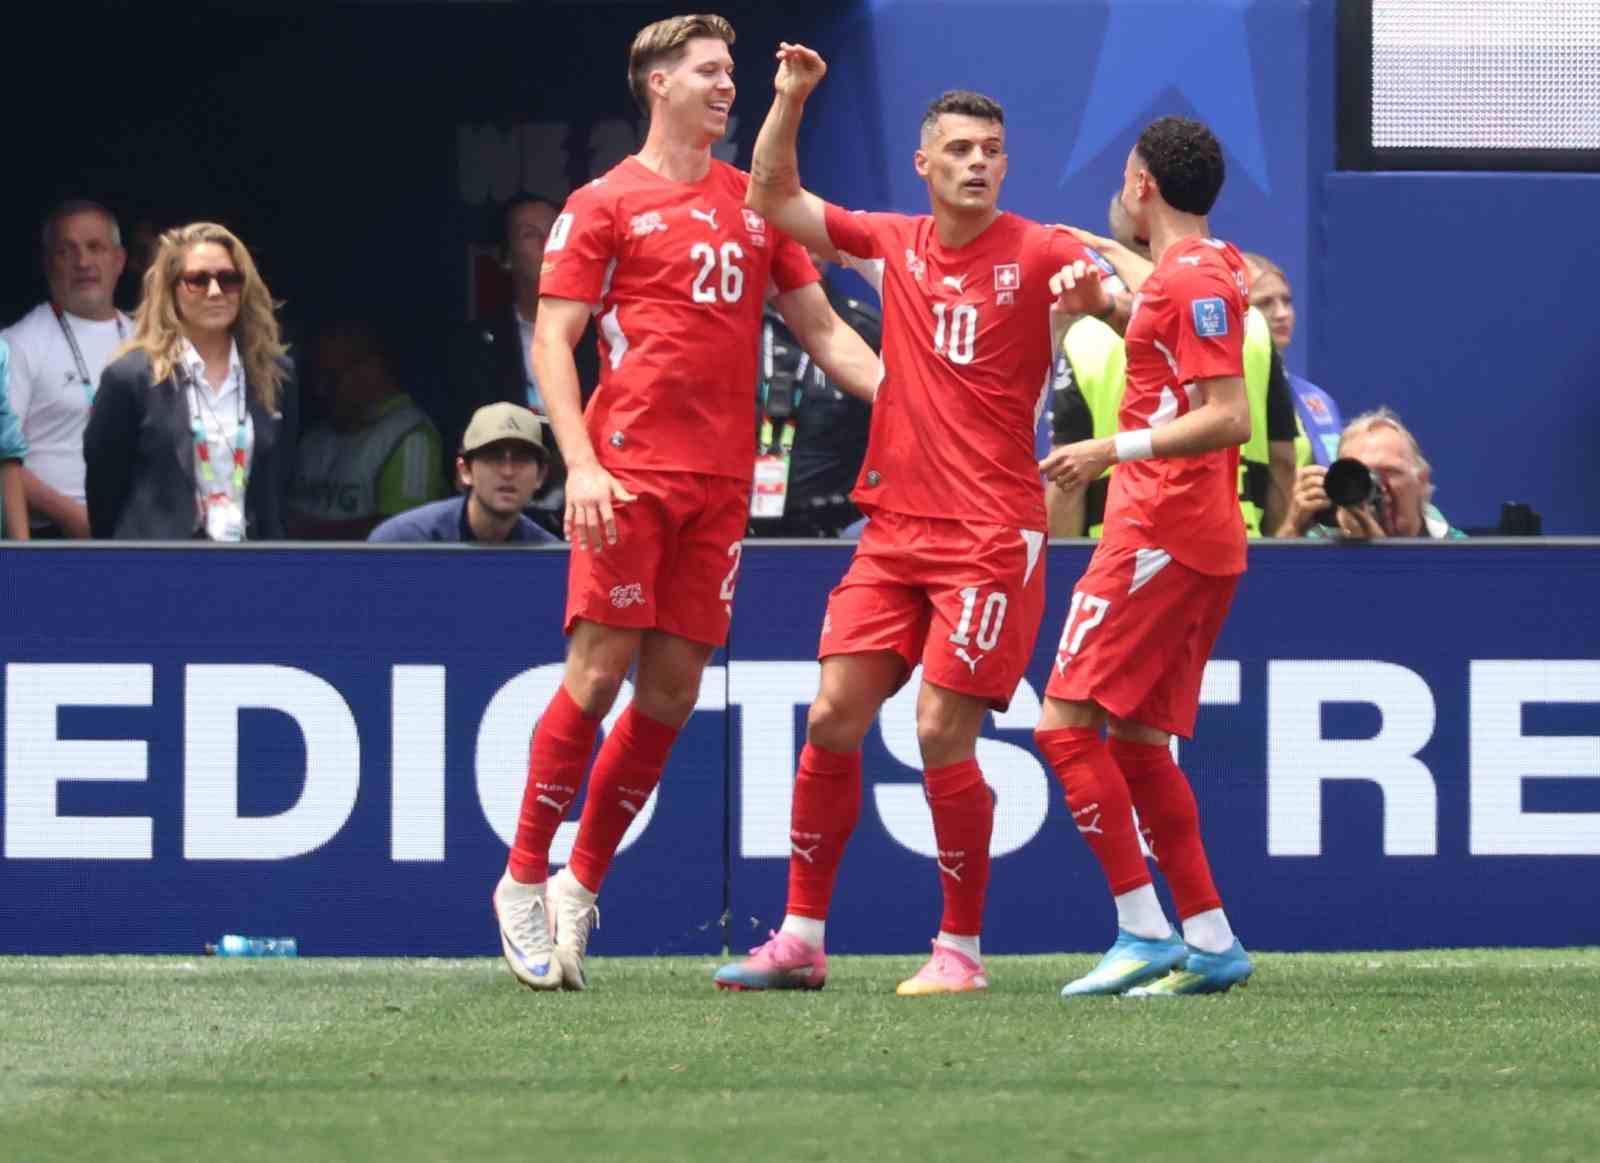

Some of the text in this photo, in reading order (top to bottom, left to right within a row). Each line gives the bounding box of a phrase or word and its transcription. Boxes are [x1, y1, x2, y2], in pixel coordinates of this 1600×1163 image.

[690, 241, 743, 304] 26
[931, 303, 979, 365] 10
[949, 586, 1008, 652] 10
[1057, 588, 1111, 656] 17
[4, 659, 1600, 862] EDICTSRE
